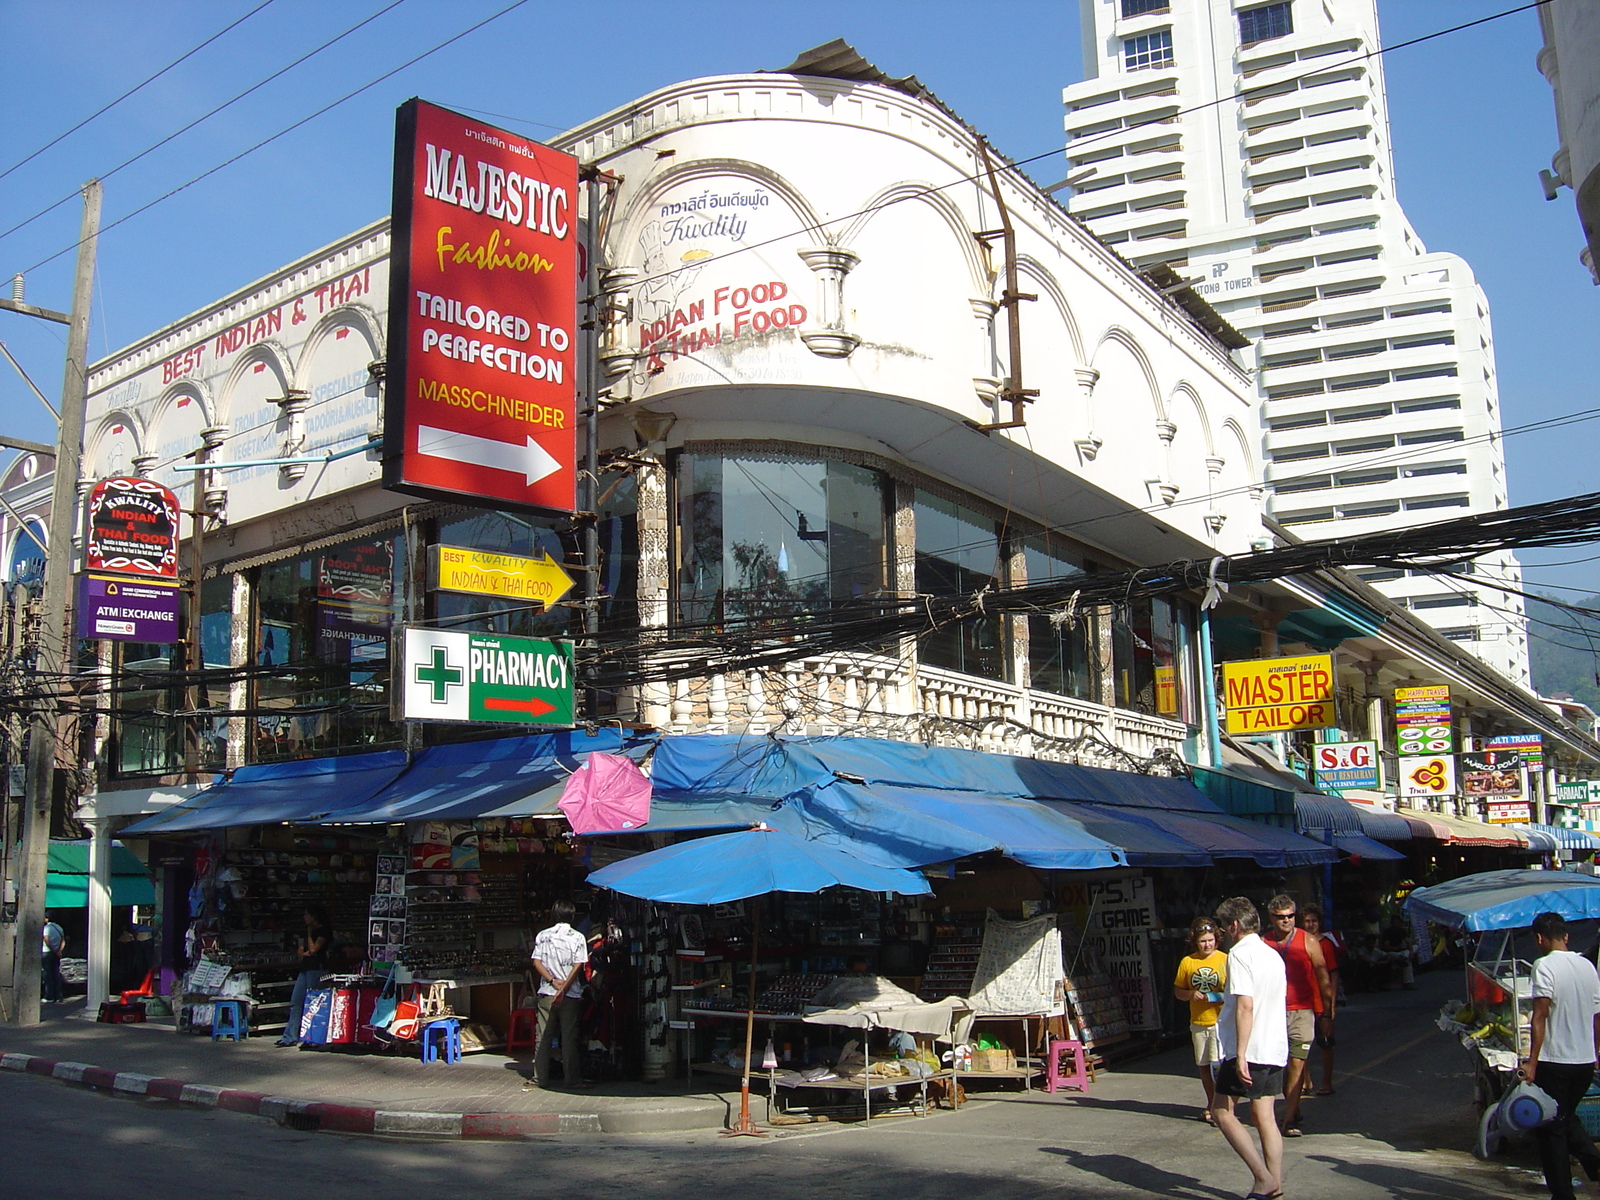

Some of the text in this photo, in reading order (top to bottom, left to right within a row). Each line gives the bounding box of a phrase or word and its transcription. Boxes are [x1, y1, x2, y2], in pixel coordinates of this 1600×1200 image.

[424, 142, 569, 240] MAJESTIC
[662, 213, 747, 246] Kwality
[437, 226, 554, 275] Fashion
[1224, 277, 1252, 291] TOWER
[416, 290, 569, 352] TAILORED TO
[640, 281, 787, 349] INDIAN FOOD
[162, 268, 370, 385] BEST INDIAN & THAI
[646, 304, 807, 376] & THAI FOOD
[422, 328, 563, 385] PERFECTION
[418, 377, 565, 429] MASSCHNEIDER
[104, 495, 164, 516] KWALITY
[111, 508, 156, 524] INDIAN
[126, 521, 135, 530] &
[97, 528, 127, 539] THAI
[133, 533, 169, 545] FOOD
[443, 551, 465, 565] BEST
[471, 553, 527, 569] KWALITY
[451, 571, 487, 590] INDIAN
[502, 576, 523, 595] THAI
[526, 580, 553, 598] FOOD
[96, 606, 174, 622] ATM EXCHANGE
[470, 648, 569, 690] PHARMACY
[1228, 670, 1330, 707] MASTER
[1426, 688, 1449, 697] TRAVEL
[1238, 705, 1325, 729] TAILOR
[1511, 734, 1541, 743] TRAVEL
[1463, 757, 1495, 771] MARCO
[1497, 755, 1518, 770] POLO
[1339, 769, 1375, 780] RESTAURANT
[1102, 908, 1150, 928] GAME
[1109, 935, 1141, 957] MUSIC
[1110, 961, 1142, 978] MOVIE
[1118, 979, 1143, 993] CUBE
[1123, 995, 1144, 1008] BOY
